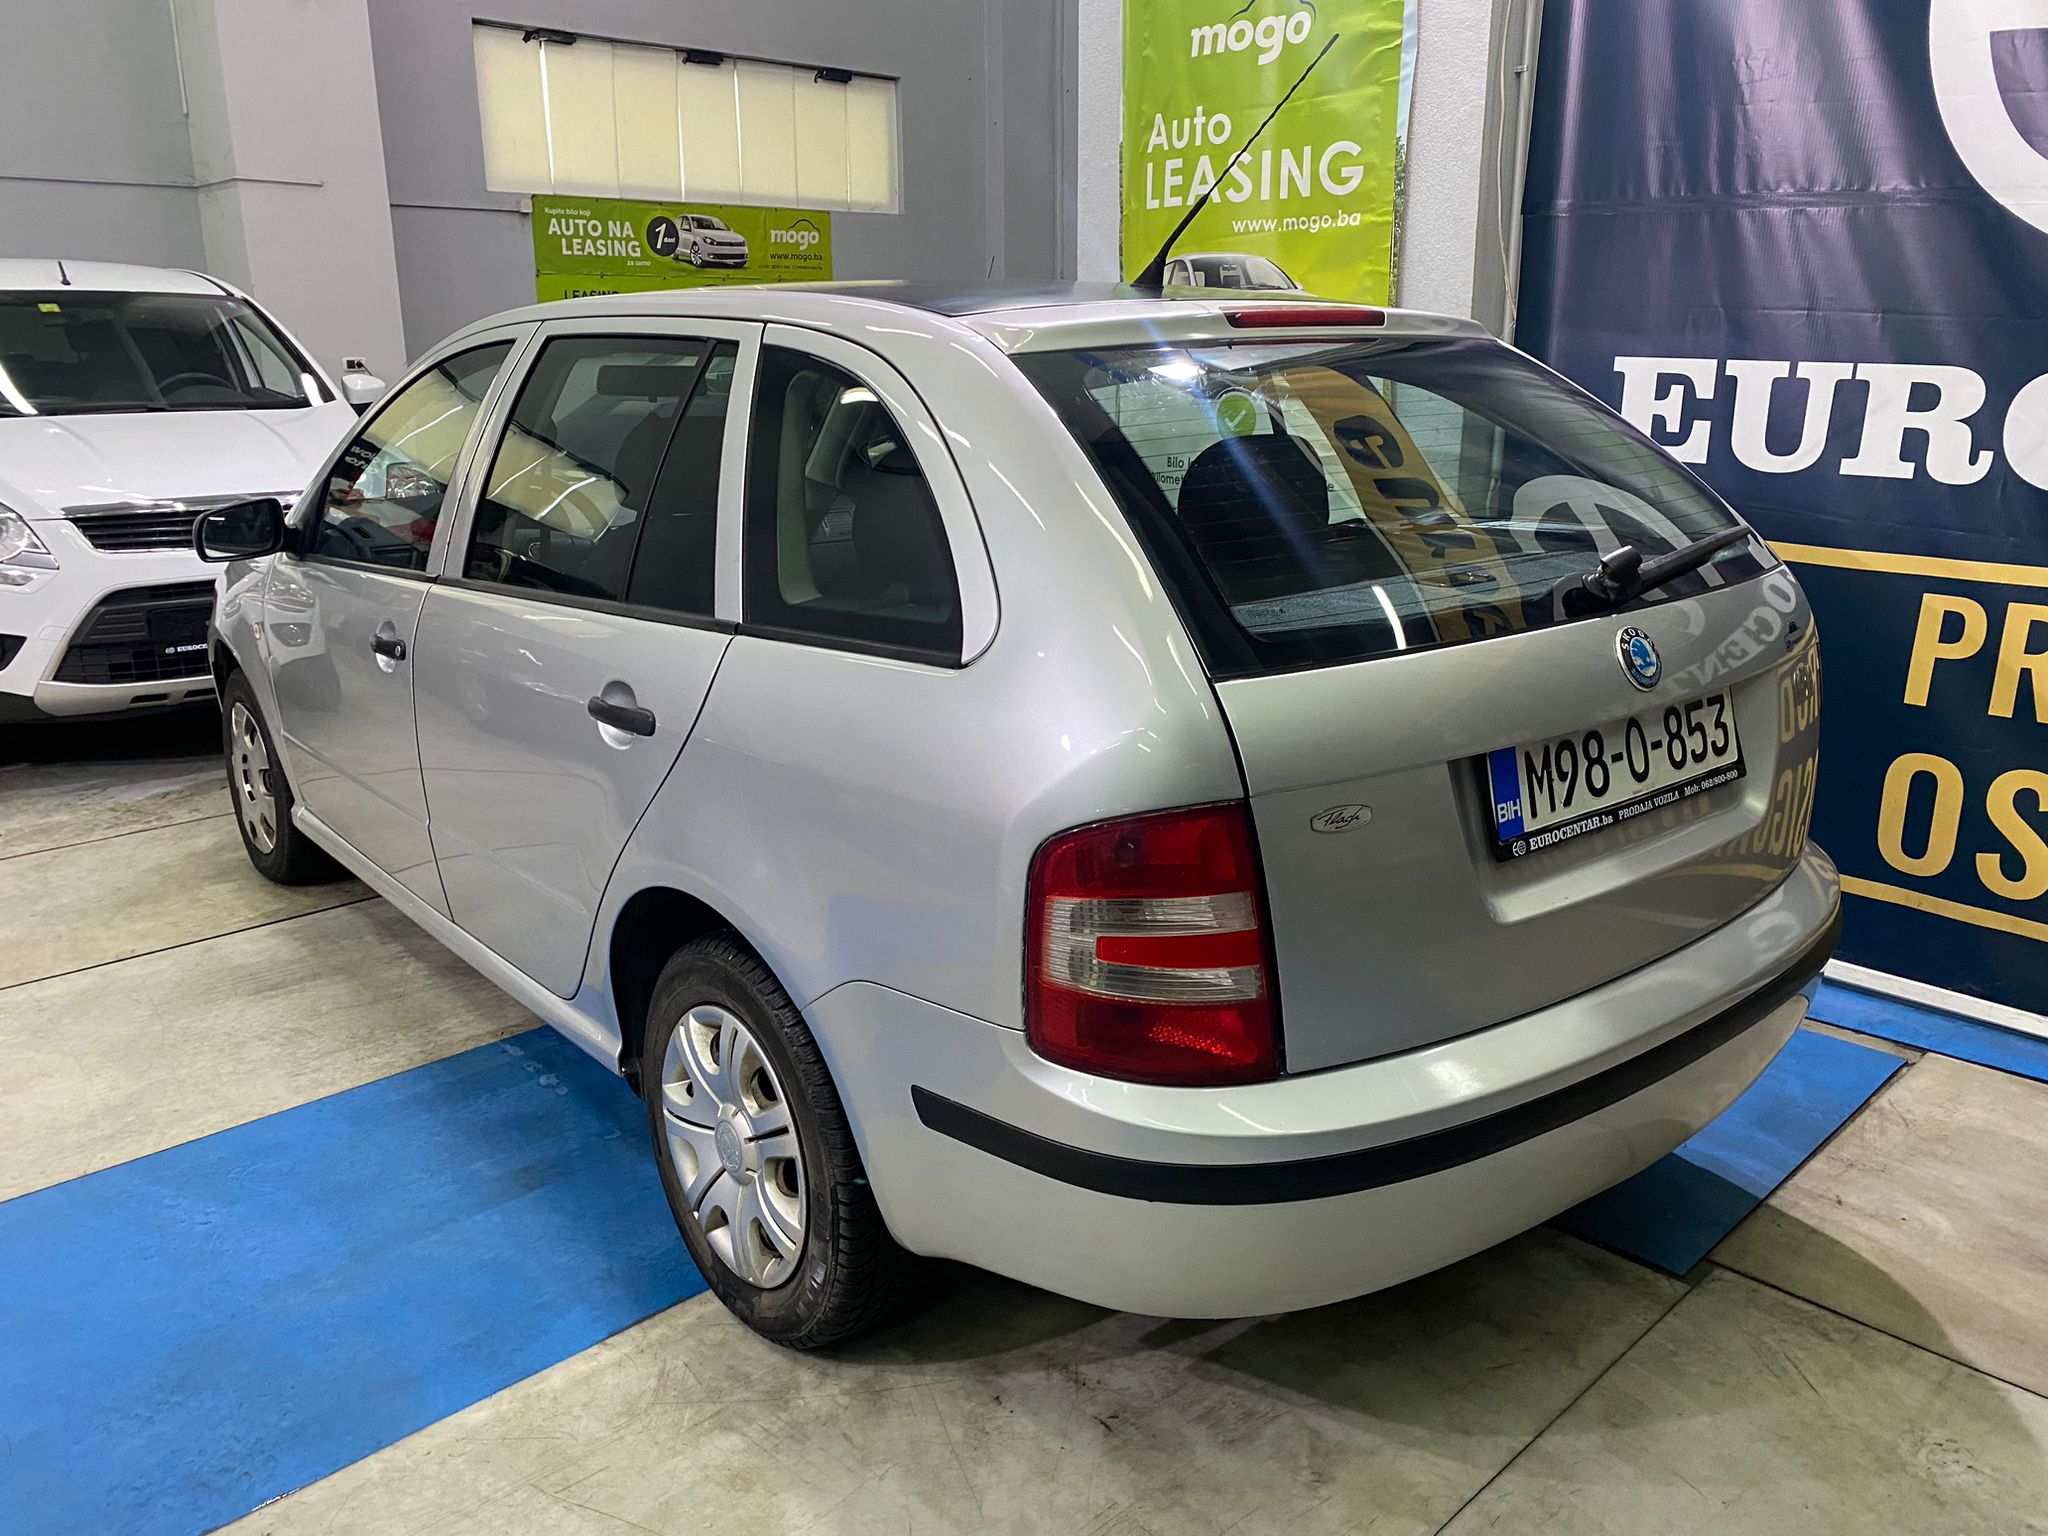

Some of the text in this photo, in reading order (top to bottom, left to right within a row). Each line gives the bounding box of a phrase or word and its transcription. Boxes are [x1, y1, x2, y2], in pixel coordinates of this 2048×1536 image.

[1191, 11, 1312, 66] mogo
[1147, 105, 1232, 153] Auto
[1146, 140, 1364, 210] LEASING
[548, 218, 635, 238] AUTO NA
[1232, 210, 1361, 233] www.mogo.ba
[561, 238, 641, 257] LEASING
[655, 223, 667, 249] 1
[770, 229, 820, 251] mogo
[770, 252, 823, 262] www.mogo.ba
[1167, 456, 1184, 468] Bilo
[1497, 798, 1522, 823] BIH
[1619, 799, 1653, 820] PRODAJA
[1653, 790, 1680, 807] VOZILA
[1684, 784, 1700, 796] Mob:
[1529, 814, 1614, 850] EUROCENTAR.ba
[1877, 752, 2048, 901] OS
